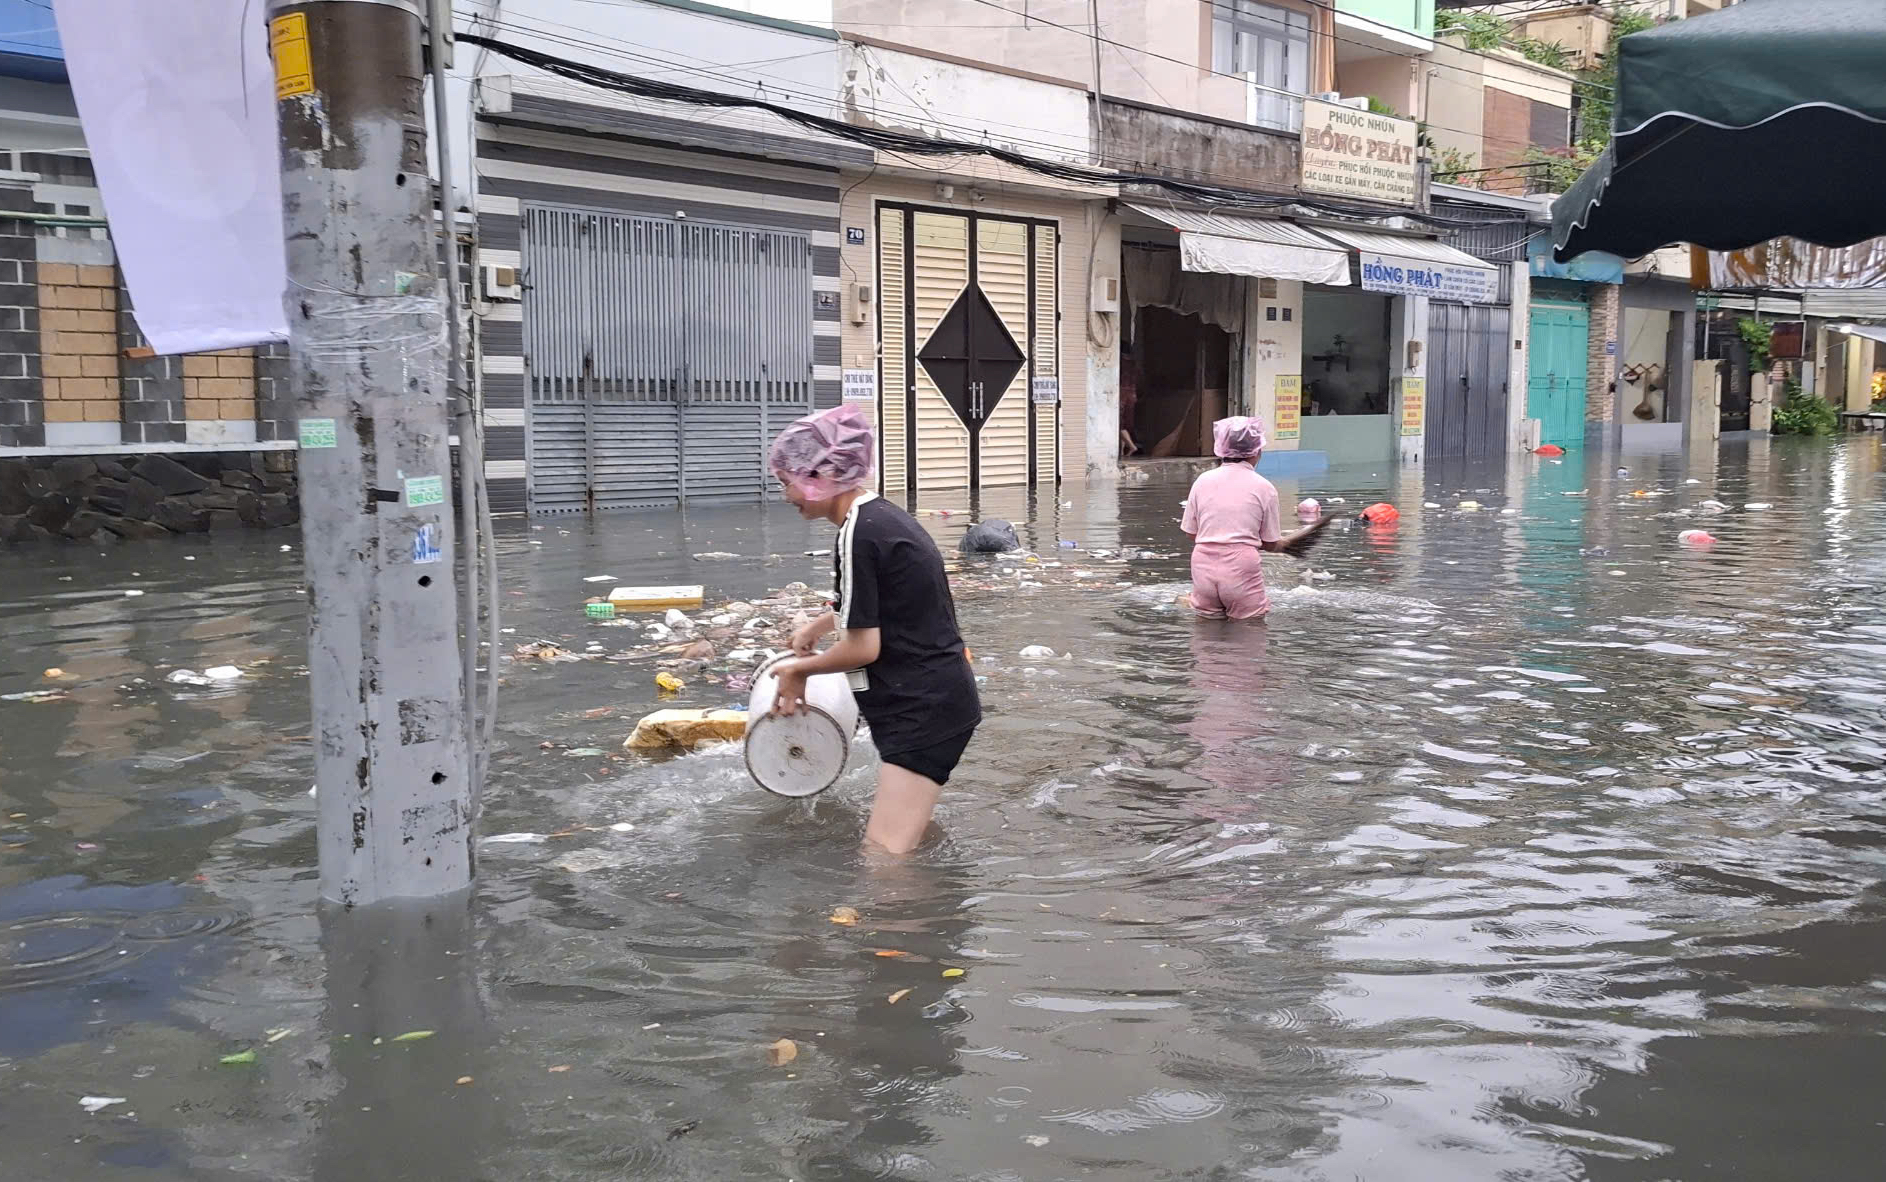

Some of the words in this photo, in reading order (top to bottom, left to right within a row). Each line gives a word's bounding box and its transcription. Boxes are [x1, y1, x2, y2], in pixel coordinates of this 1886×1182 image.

[1329, 111, 1364, 127] PHUỘC
[1368, 119, 1395, 133] NHÚN
[1305, 123, 1362, 157] HỒNG
[1366, 139, 1413, 165] PHÁT
[1335, 175, 1342, 184] XE
[849, 229, 863, 239] 70
[1363, 257, 1403, 284] HỒNG
